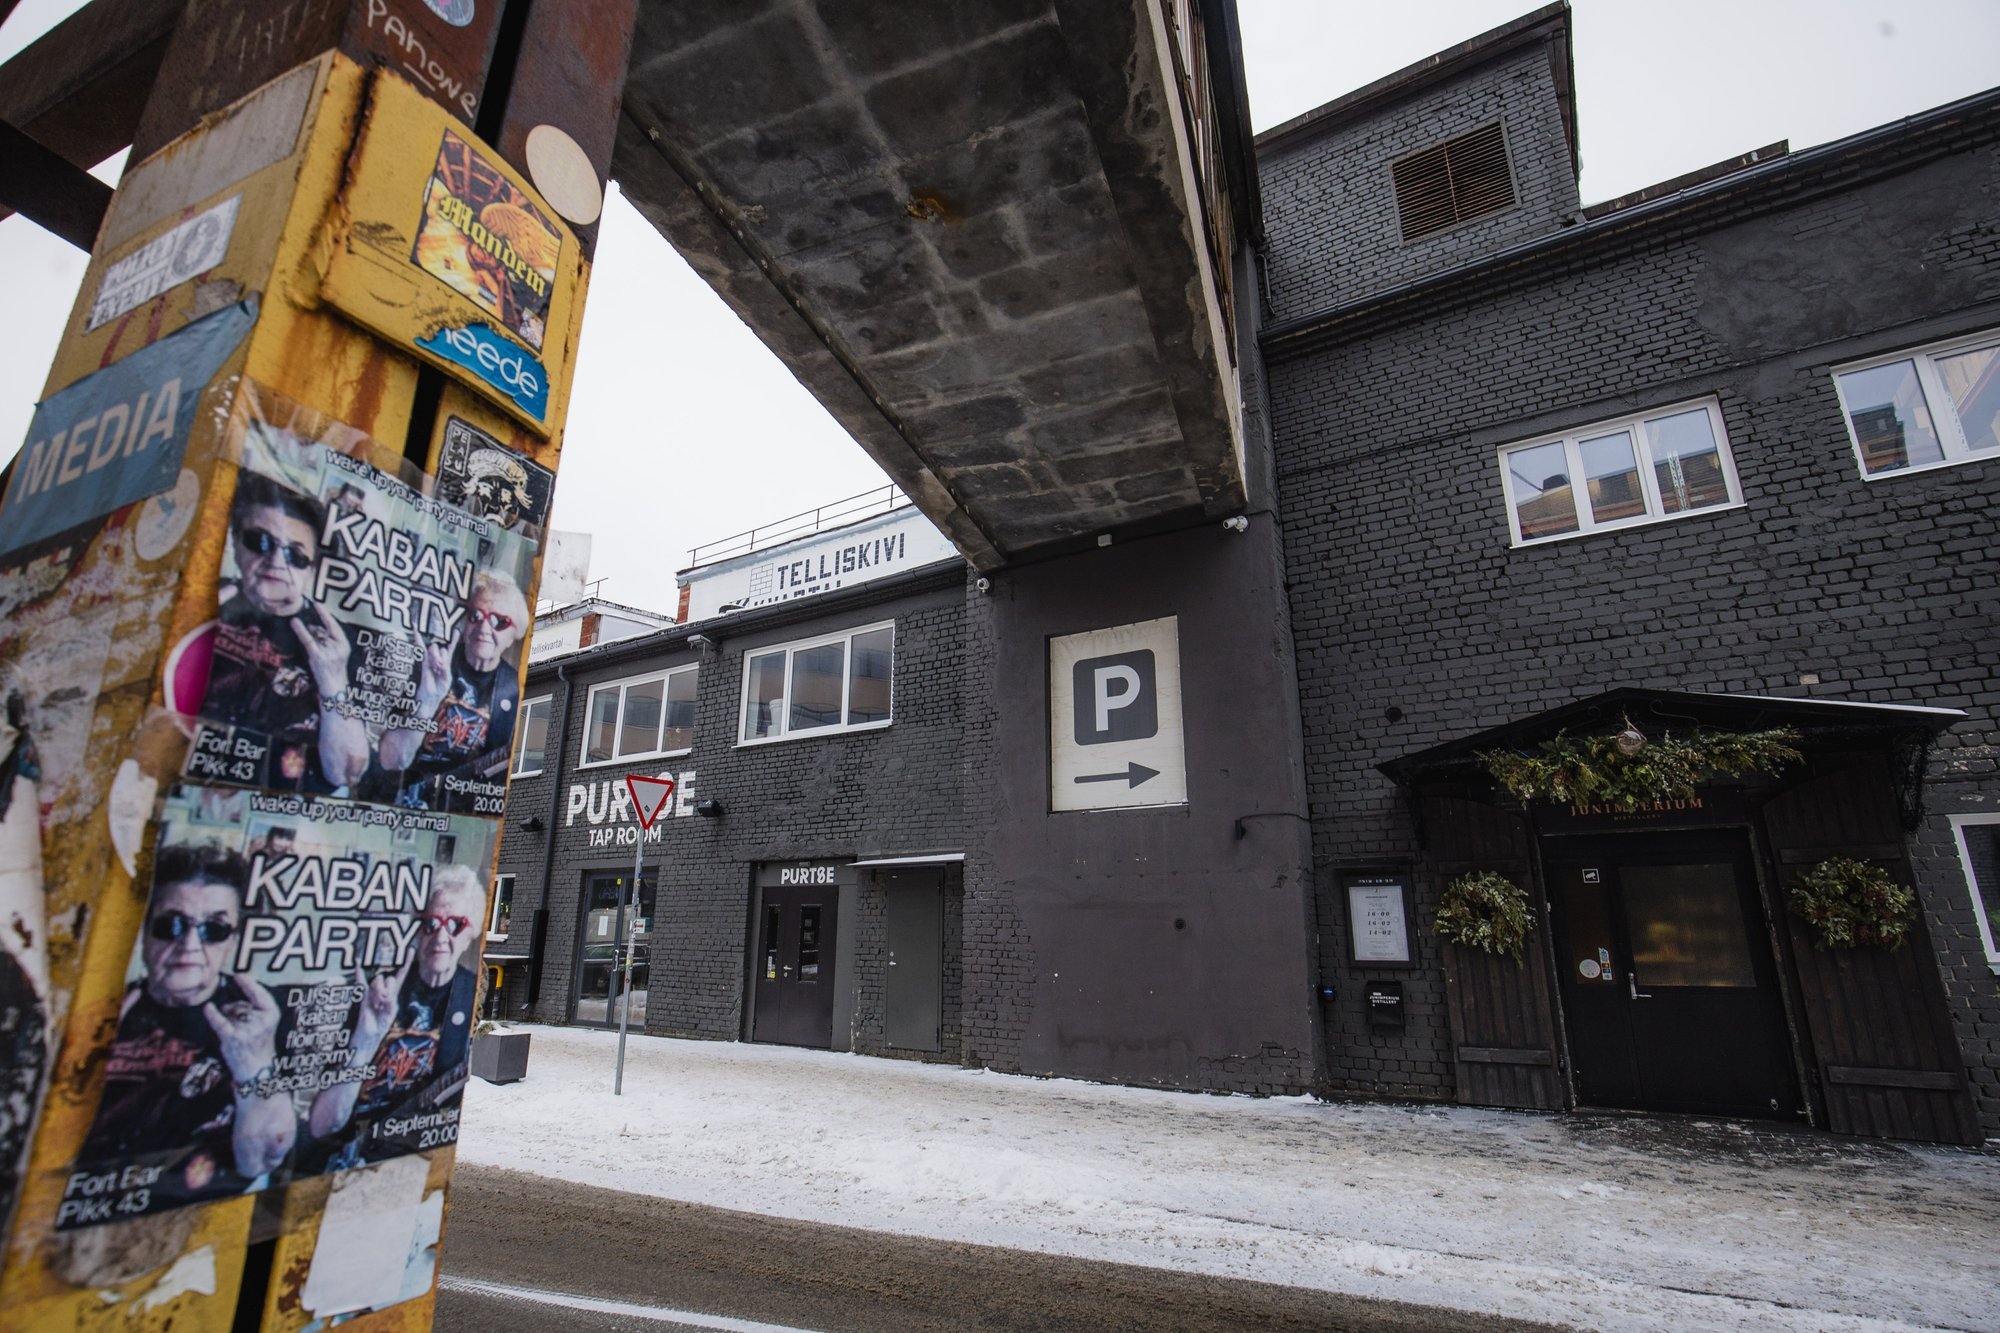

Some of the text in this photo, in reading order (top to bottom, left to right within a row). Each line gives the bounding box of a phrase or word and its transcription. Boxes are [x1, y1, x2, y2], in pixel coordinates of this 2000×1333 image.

[437, 195, 546, 297] Mandem
[15, 377, 182, 505] MEDIA
[326, 450, 489, 536] wake up your party animal
[320, 502, 473, 601] KABAN
[777, 532, 905, 590] TELLISKIVI
[314, 556, 466, 641] PARTY
[365, 648, 413, 675] kaban
[1094, 664, 1141, 732] P
[337, 702, 386, 724] special
[387, 713, 439, 733] guests
[196, 730, 268, 760] Fort Bar
[229, 761, 256, 780] 43
[434, 773, 507, 796] 1 September
[251, 796, 450, 832] wake up your party animal
[474, 796, 506, 813] 20:00
[589, 828, 614, 846] TAP
[243, 853, 431, 911] KABAN
[236, 918, 422, 972] PARTY
[297, 1008, 349, 1026] kaban
[256, 1071, 320, 1097] special
[320, 1064, 377, 1090] guests
[372, 1122, 379, 1139] 1
[116, 1188, 151, 1214] 43
